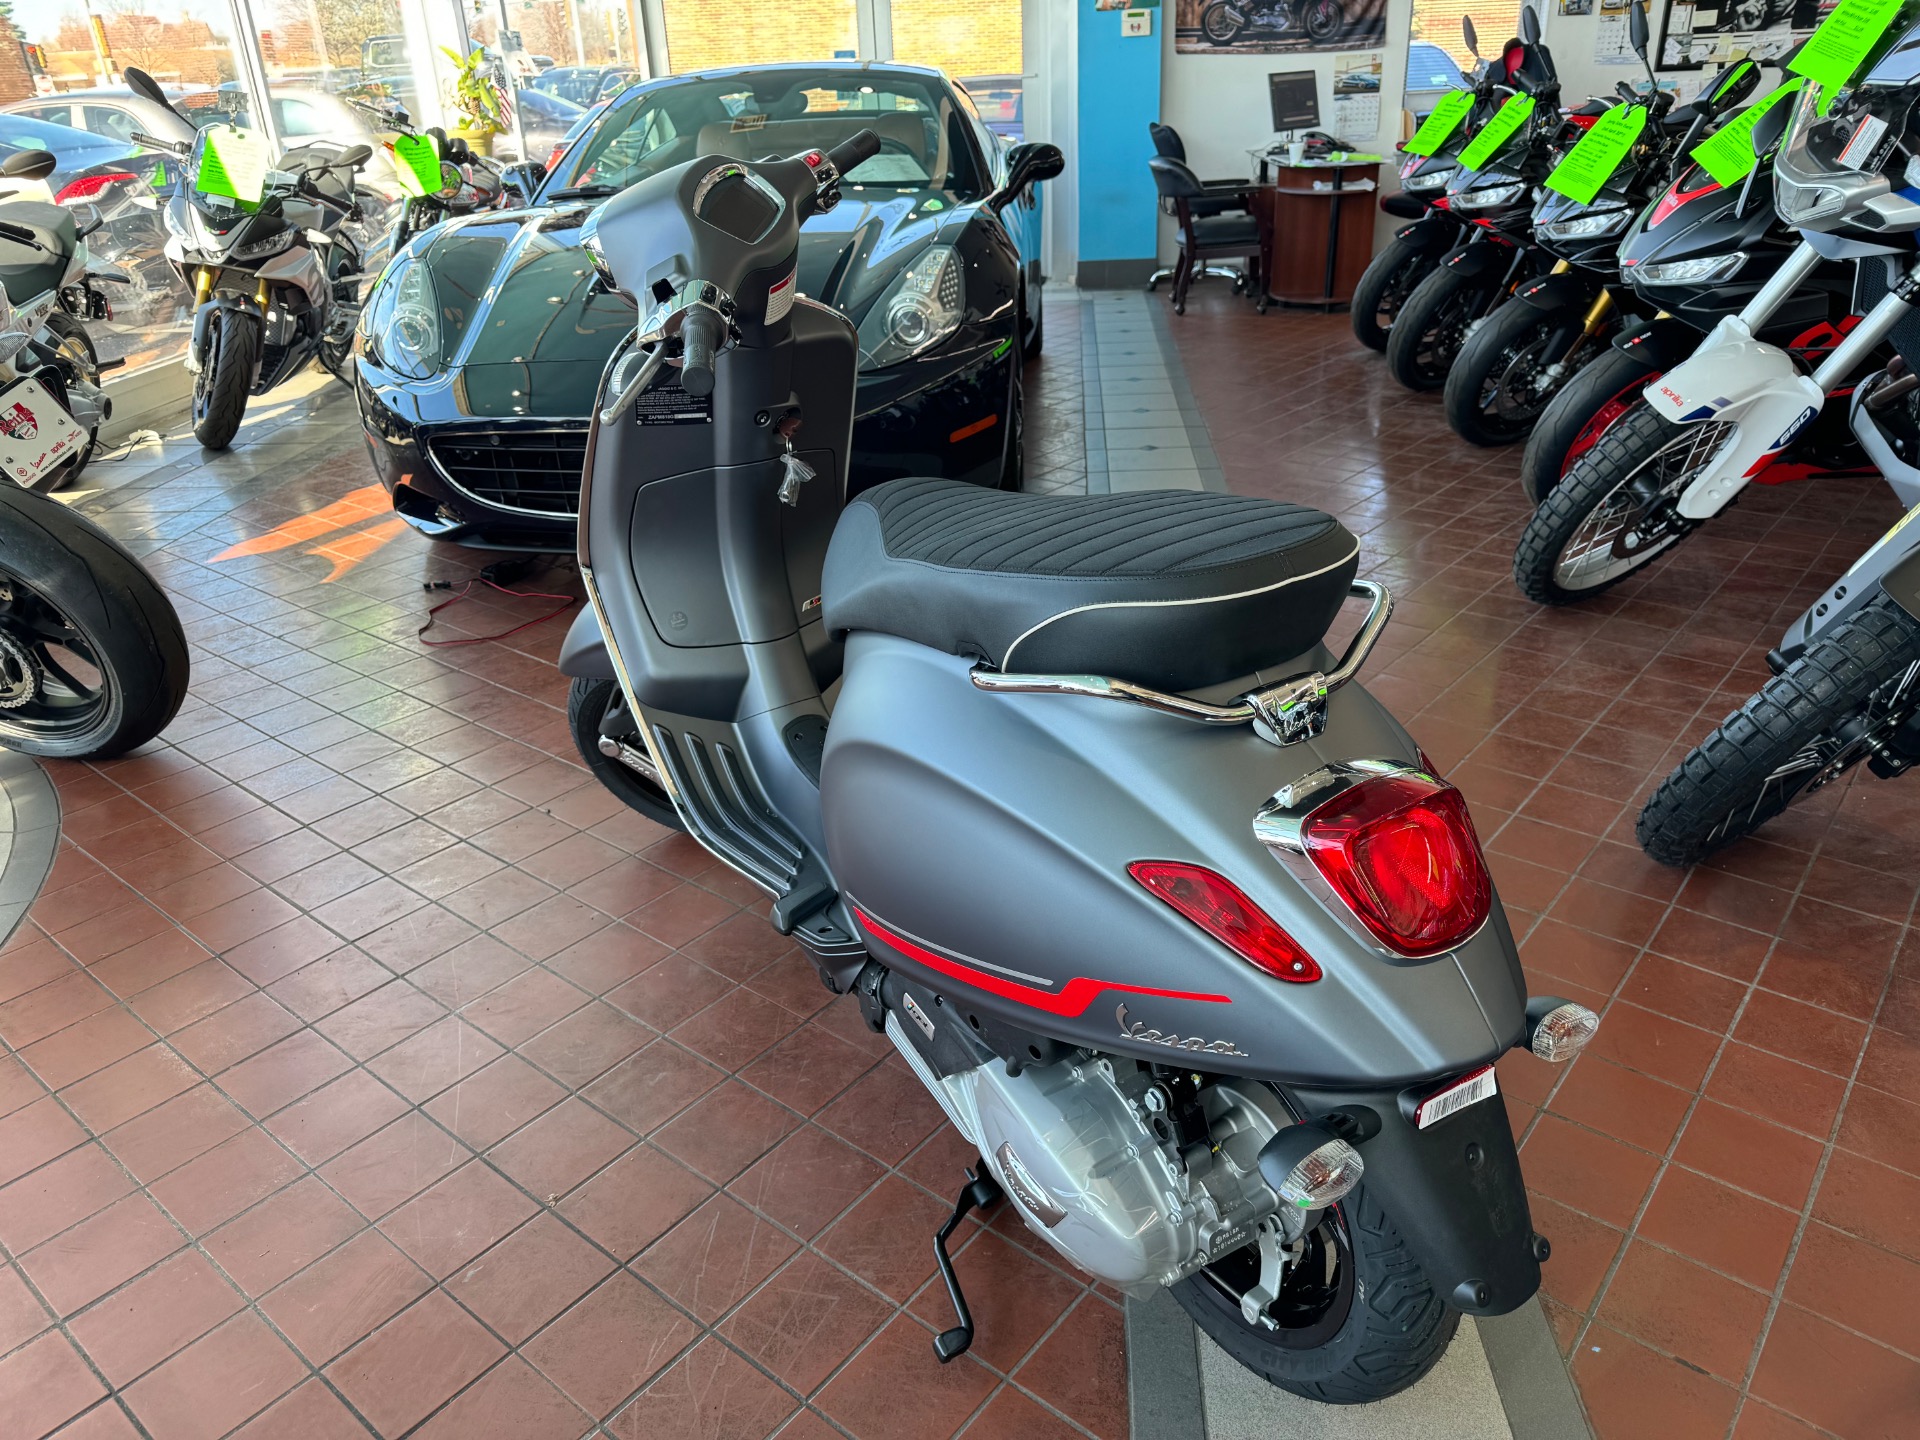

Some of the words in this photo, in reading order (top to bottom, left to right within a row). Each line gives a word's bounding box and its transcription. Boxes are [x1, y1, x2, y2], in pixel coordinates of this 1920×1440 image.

[1661, 386, 1684, 407] aprilia
[0, 407, 34, 437] Reina
[1779, 408, 1811, 446] 660
[50, 440, 66, 455] aprilia
[30, 452, 47, 470] Vespa
[1115, 1003, 1249, 1057] Vespa
